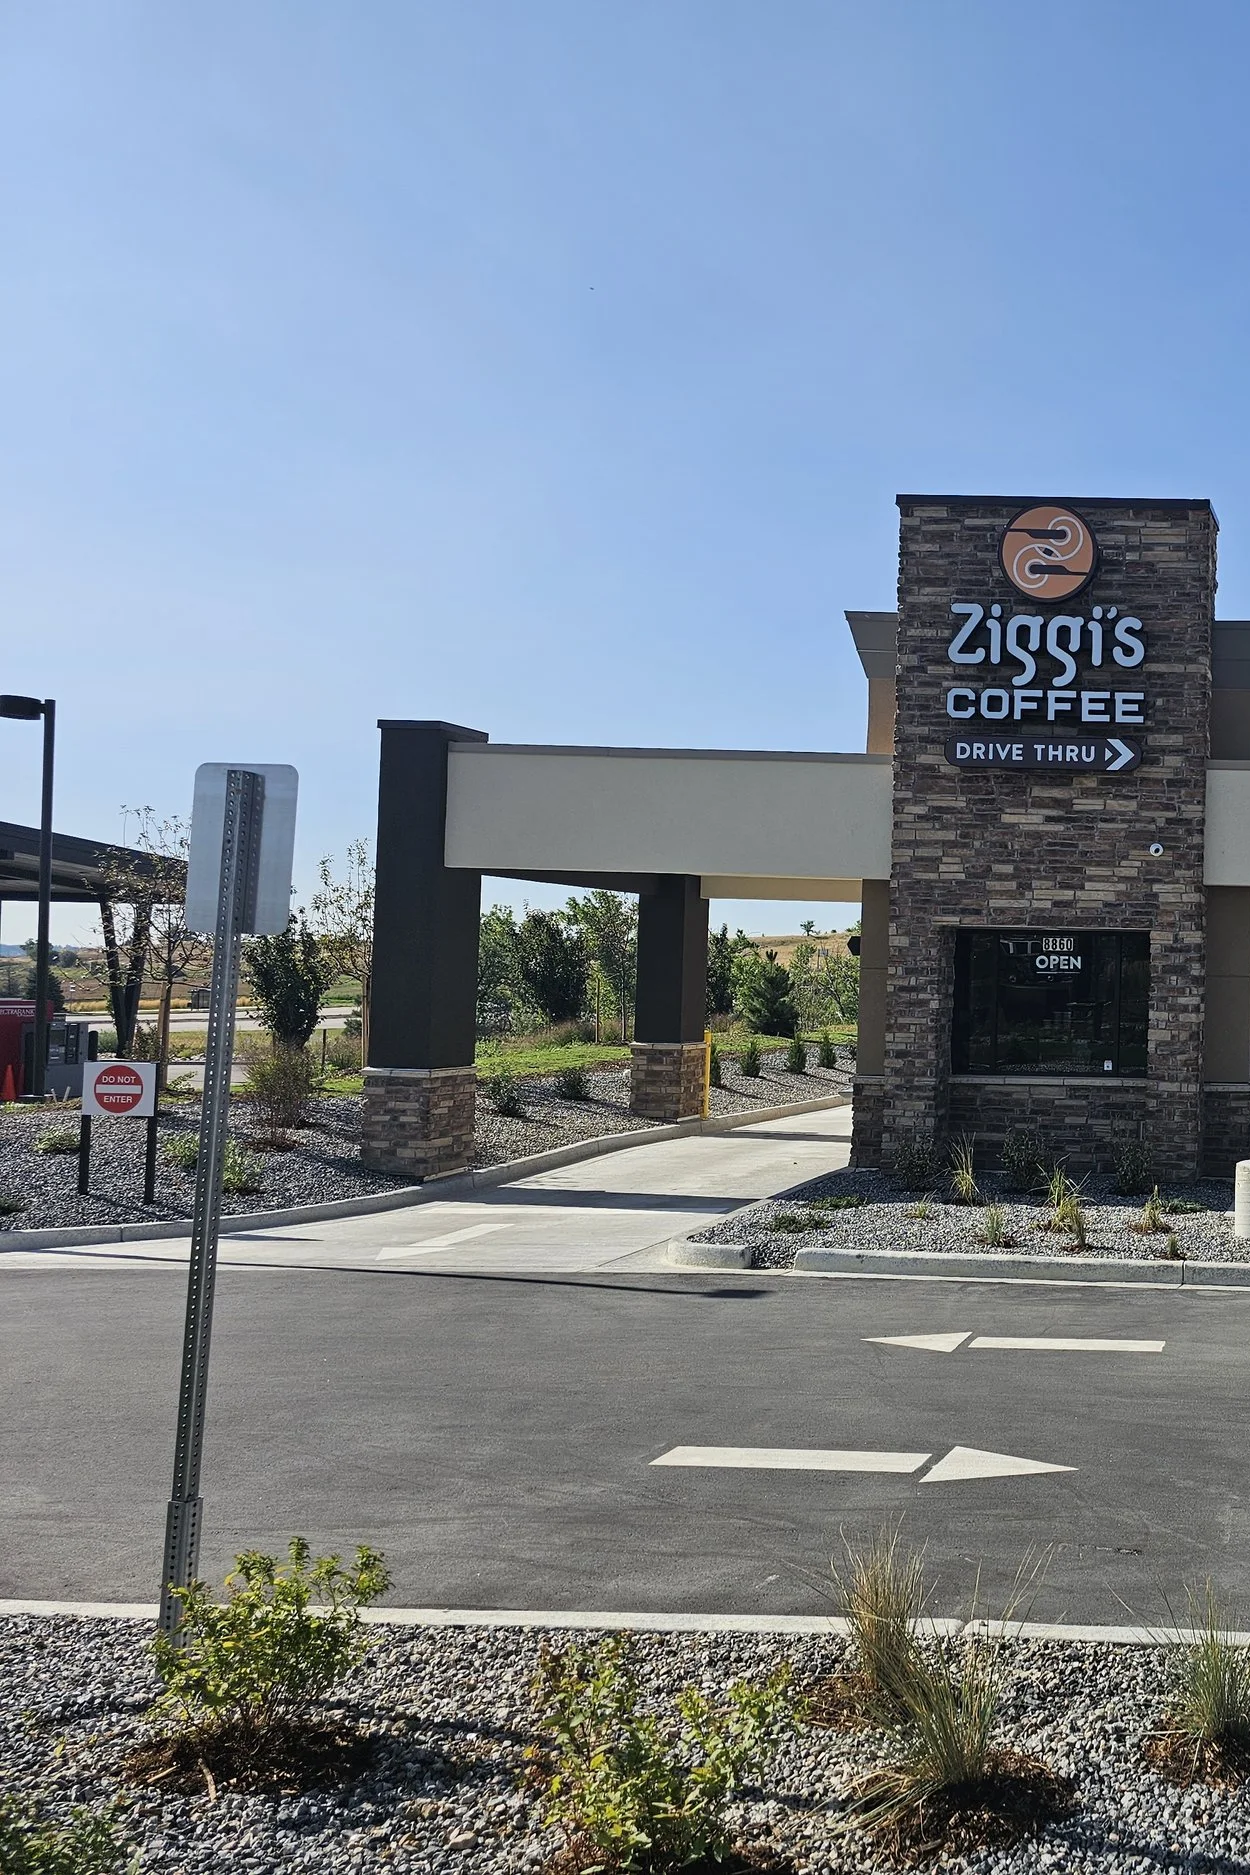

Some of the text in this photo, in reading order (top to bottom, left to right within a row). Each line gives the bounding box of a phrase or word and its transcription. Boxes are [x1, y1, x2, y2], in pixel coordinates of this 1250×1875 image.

[947, 603, 1145, 687] Ziggi's
[946, 687, 1145, 724] COFFEE
[956, 742, 1096, 763] DRIVE THRU
[1044, 938, 1073, 951] 8860
[1035, 955, 1082, 969] OPEN
[102, 1075, 136, 1084] DO NOT
[103, 1095, 133, 1103] ENTER
